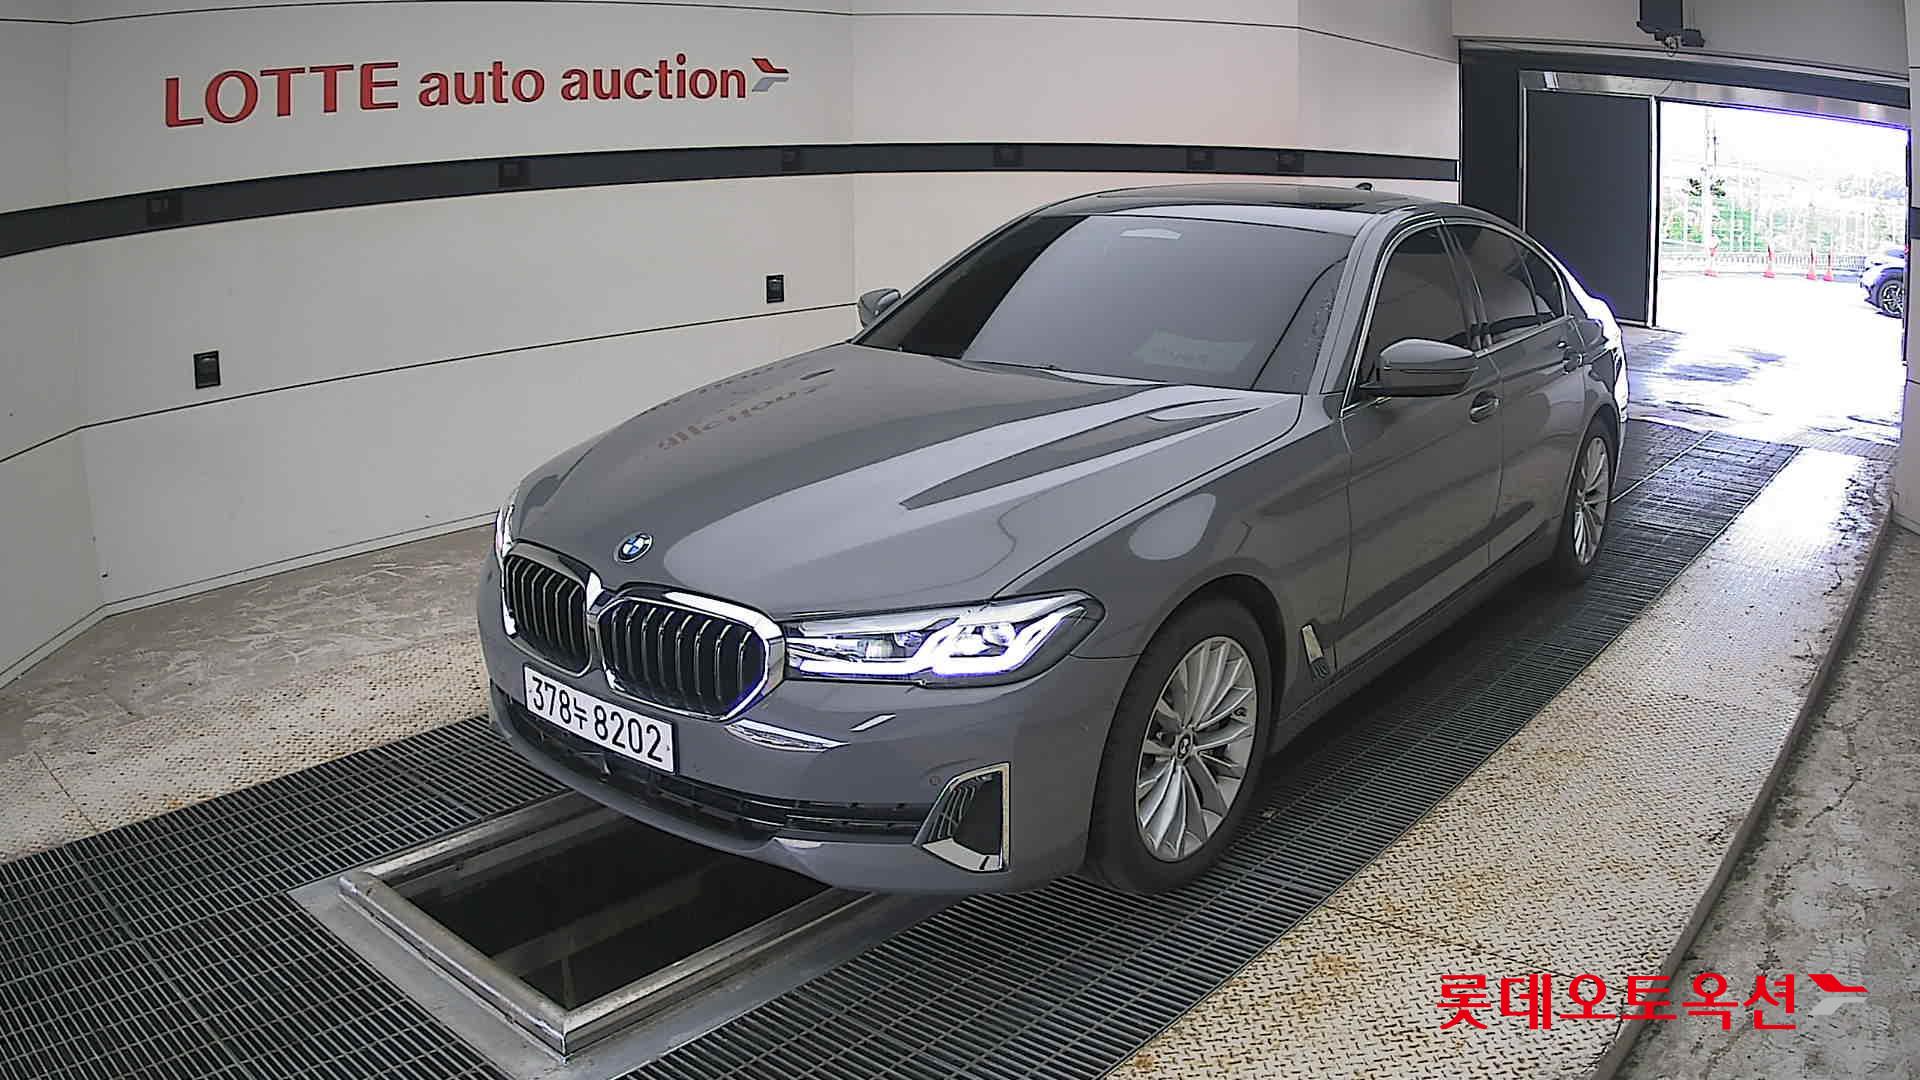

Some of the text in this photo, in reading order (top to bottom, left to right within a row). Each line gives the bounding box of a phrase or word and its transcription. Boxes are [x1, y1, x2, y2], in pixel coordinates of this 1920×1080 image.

[164, 53, 747, 128] LOTTE auto auction
